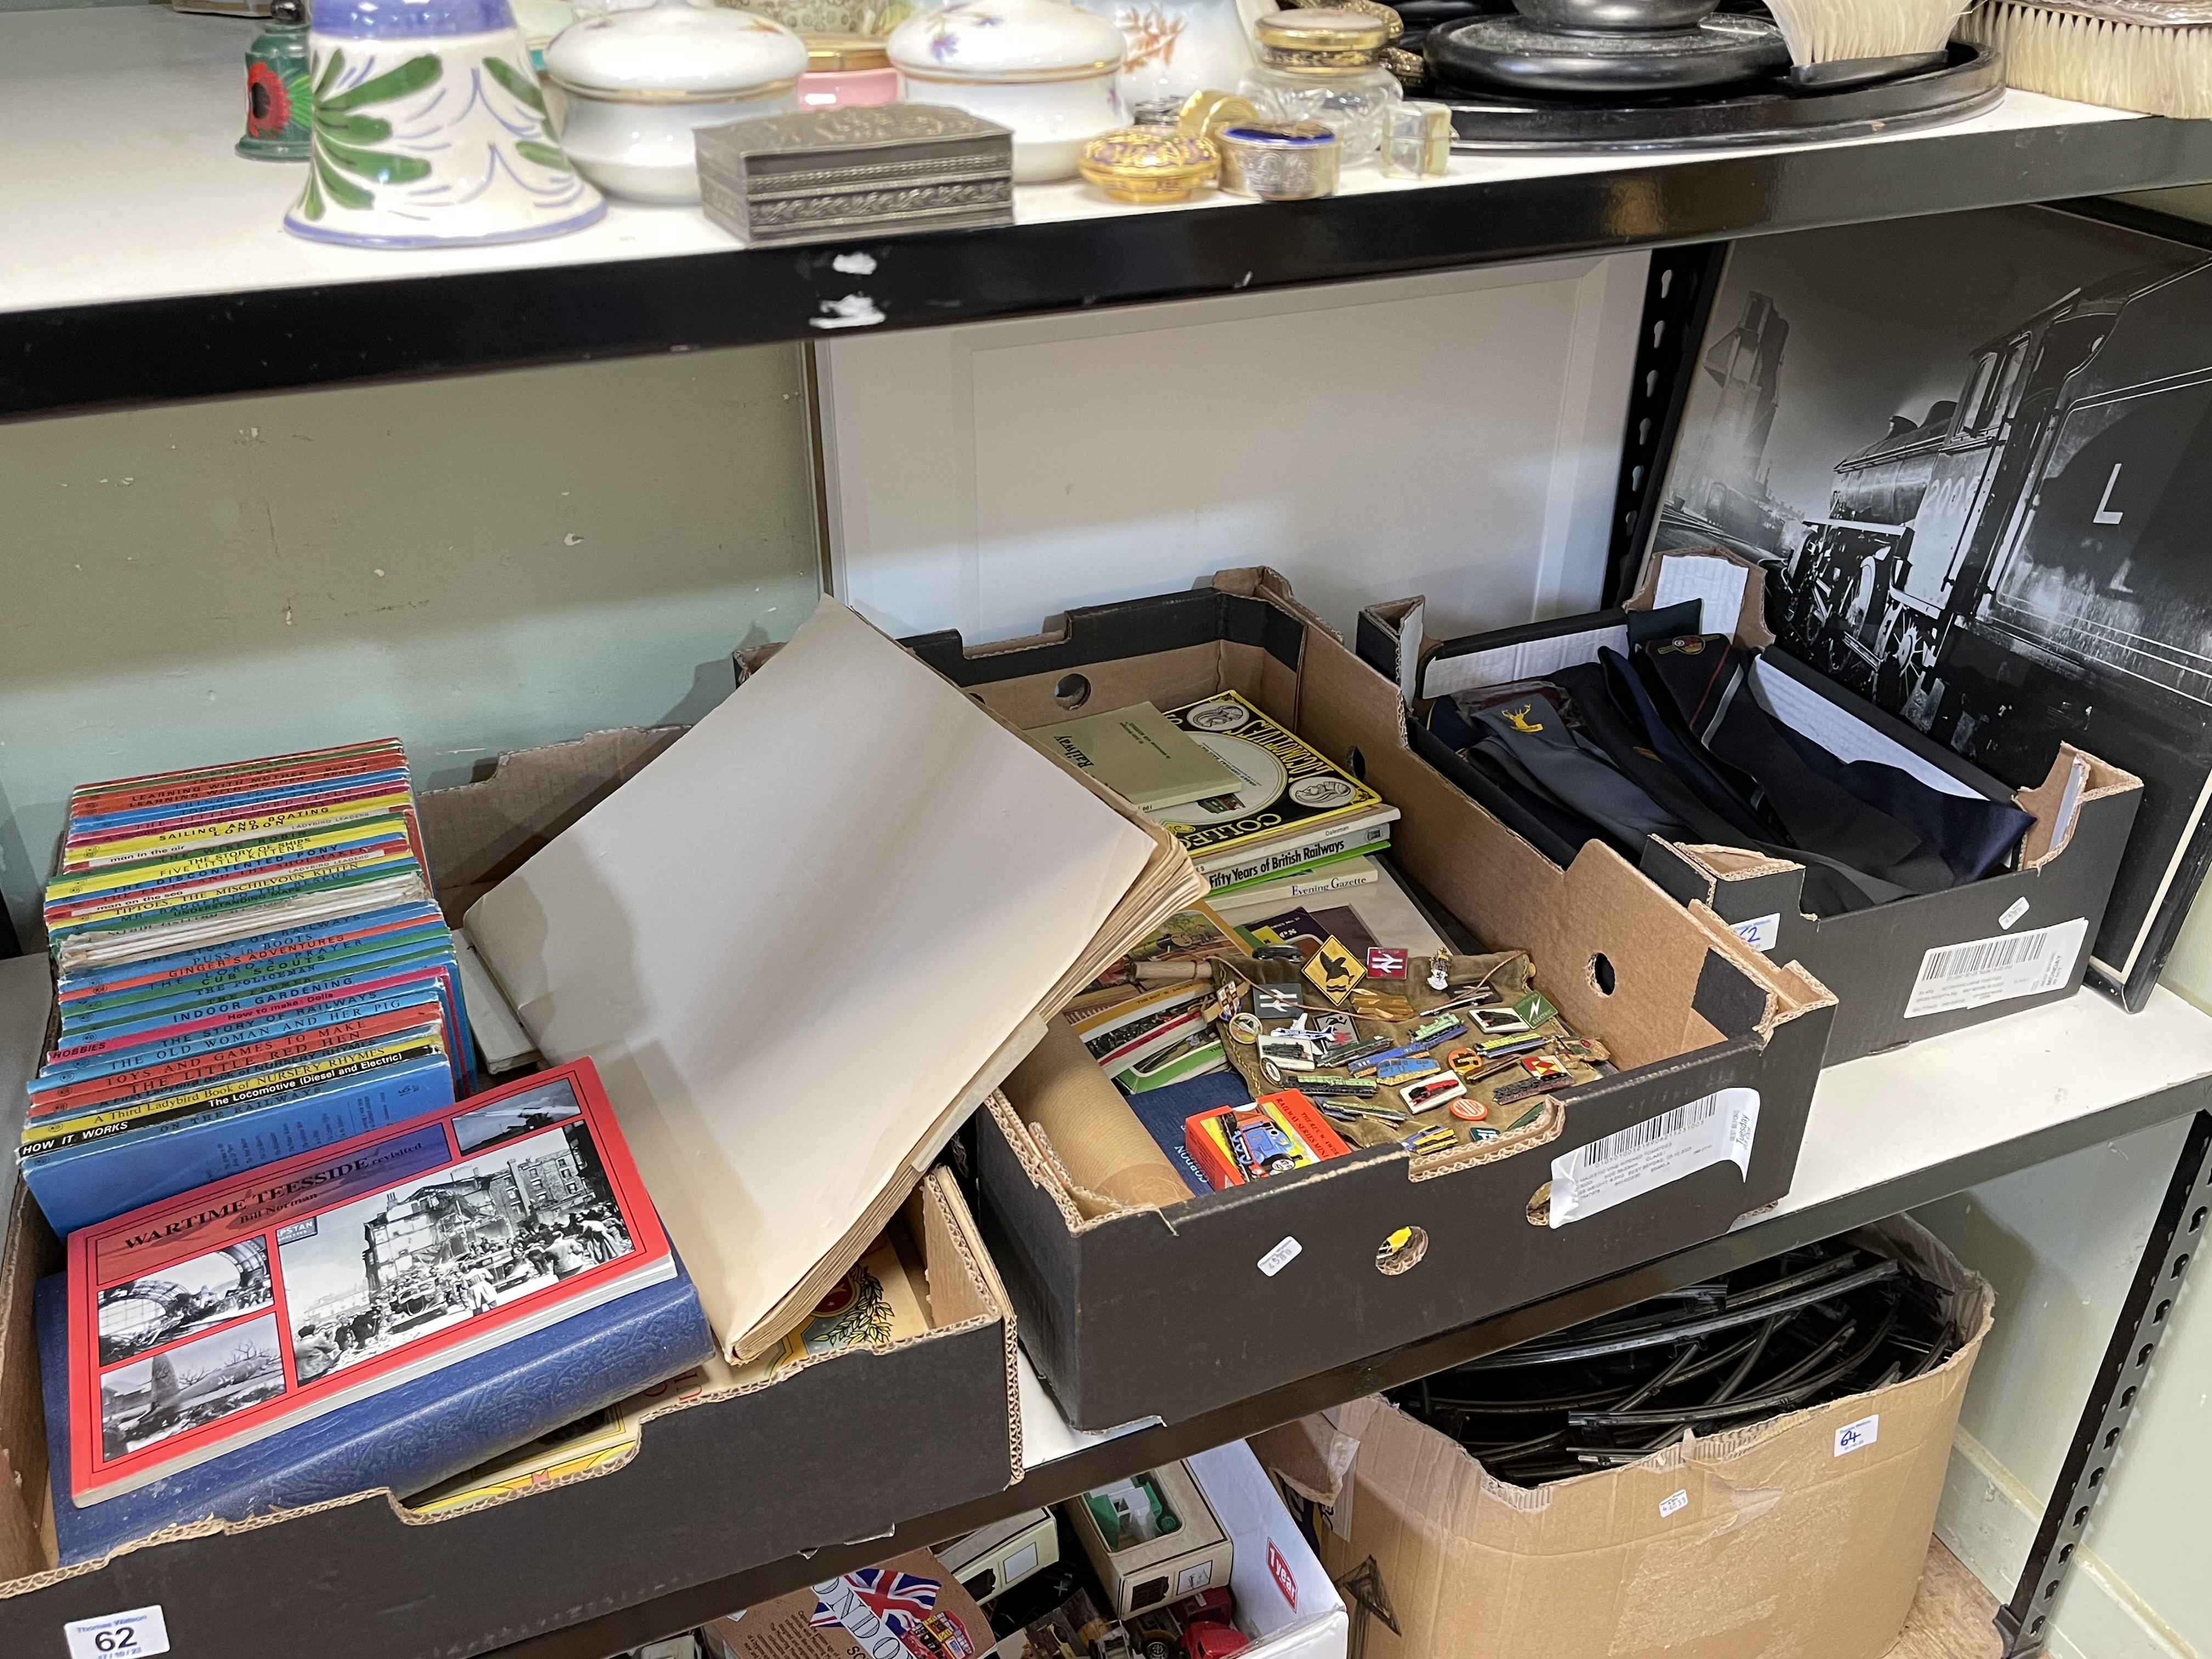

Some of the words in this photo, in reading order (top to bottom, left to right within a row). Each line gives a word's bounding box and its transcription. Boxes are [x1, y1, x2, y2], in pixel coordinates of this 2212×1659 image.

[2094, 464, 2123, 524] L
[1054, 736, 1093, 768] Railway
[1224, 720, 1334, 783] LOCOMOTIVES
[130, 793, 198, 808] LEARNING
[207, 787, 241, 795] WITH
[249, 777, 304, 788] MOTHER
[133, 787, 201, 801] LEARNING
[210, 781, 243, 790] WITH
[252, 771, 306, 783] MOTHER
[159, 827, 216, 841] SAILING
[228, 819, 256, 829] AND
[268, 808, 329, 822] BOATING
[213, 820, 284, 836] LONDON
[258, 831, 307, 844] ROBIN
[292, 820, 331, 830] LADYBIRD
[335, 813, 369, 822] LEADERS
[1325, 825, 1350, 837] Dalesman
[110, 854, 134, 862] man
[151, 848, 169, 856] the
[160, 866, 190, 876] FIVE
[198, 856, 240, 870] LITTLE
[249, 844, 304, 860] KITTENS
[189, 855, 210, 865] THE
[215, 848, 253, 861] STORY
[258, 844, 273, 853] OF
[279, 837, 312, 849] SHIPS
[289, 862, 329, 873] LADYBIRD
[334, 854, 369, 864] LEADERS
[1209, 871, 1231, 888] Fifty
[1232, 865, 1257, 882] Years
[1261, 860, 1271, 873] of
[1272, 850, 1302, 870] British
[1304, 840, 1345, 861] Railways
[114, 883, 143, 893] THE
[156, 856, 284, 885] DISCONTENTED
[298, 845, 337, 858] PONY
[182, 893, 207, 902] THE
[216, 872, 305, 895] MISCHIEVOUS
[313, 862, 358, 877] KITTEN
[174, 895, 266, 917] UNDERSTANDING
[274, 887, 301, 897] MAPS
[1291, 881, 1330, 896] Evening
[1331, 877, 1367, 889] Gazette
[121, 914, 142, 922] MR
[194, 951, 232, 966] PUSS
[264, 934, 313, 950] BOOTS
[249, 934, 345, 960] ADVENTURES
[149, 978, 184, 990] THE
[295, 939, 362, 958] PRAYER
[196, 985, 225, 996] THE
[235, 964, 316, 987] POLICEMAN
[202, 973, 236, 986] CUB
[254, 955, 326, 975] SCOUTS
[173, 1002, 240, 1021] INDOOR
[255, 978, 352, 1004] GARDENING
[53, 1042, 106, 1059] HOBBIES
[228, 1011, 252, 1021] How
[256, 1007, 268, 1015] to
[307, 992, 334, 1003] Dolls
[111, 1056, 144, 1070] THE
[157, 1045, 191, 1059] OLD
[205, 1026, 269, 1048] WOMAN
[283, 1017, 317, 1031] AND
[330, 1008, 361, 1021] HER
[375, 1000, 401, 1013] PIG
[162, 1035, 191, 1047] THE
[202, 1020, 255, 1037] STORY
[266, 1013, 285, 1023] OF
[297, 992, 377, 1015] RAILWAYS
[106, 1070, 151, 1086] TOYS
[165, 1058, 201, 1073] AND
[214, 1041, 273, 1062] GAMES
[285, 1035, 306, 1045] TO
[318, 1021, 365, 1038] MAKE
[128, 1077, 168, 1094] THE
[184, 1057, 256, 1080] LITTLE
[270, 1045, 308, 1060] RED
[322, 1031, 360, 1047] HEN
[94, 1115, 104, 1124] A
[110, 1105, 142, 1120] Third
[147, 1092, 200, 1111] Ladybird
[205, 1084, 234, 1097] Book
[239, 1080, 250, 1090] of
[257, 1062, 323, 1085] NURSERY
[329, 1047, 385, 1067] RHYMES
[22, 1139, 55, 1155] HOW
[61, 1133, 75, 1146] IT
[82, 1121, 129, 1139] WORKS
[208, 1097, 229, 1108] The
[233, 1080, 296, 1102] Locomotive
[300, 1070, 335, 1086] (Diesel
[338, 1064, 358, 1076] and
[360, 1052, 403, 1069] Electric)
[160, 1122, 180, 1133] ON
[191, 1111, 225, 1125] THE
[234, 1086, 322, 1114] RAILWAYS
[1455, 1099, 1483, 1116] NUR
[1736, 1113, 1750, 1145] Tuesday
[125, 1198, 248, 1250] WARTIME
[252, 1157, 369, 1204] TEESSIDE
[371, 1143, 422, 1166] revisited
[239, 1210, 264, 1225] Bill
[267, 1193, 318, 1217] Norman
[1841, 1430, 1861, 1446] 64
[1269, 1547, 1276, 1566] 1
[1276, 1562, 1296, 1598] year
[95, 1627, 137, 1651] 62
